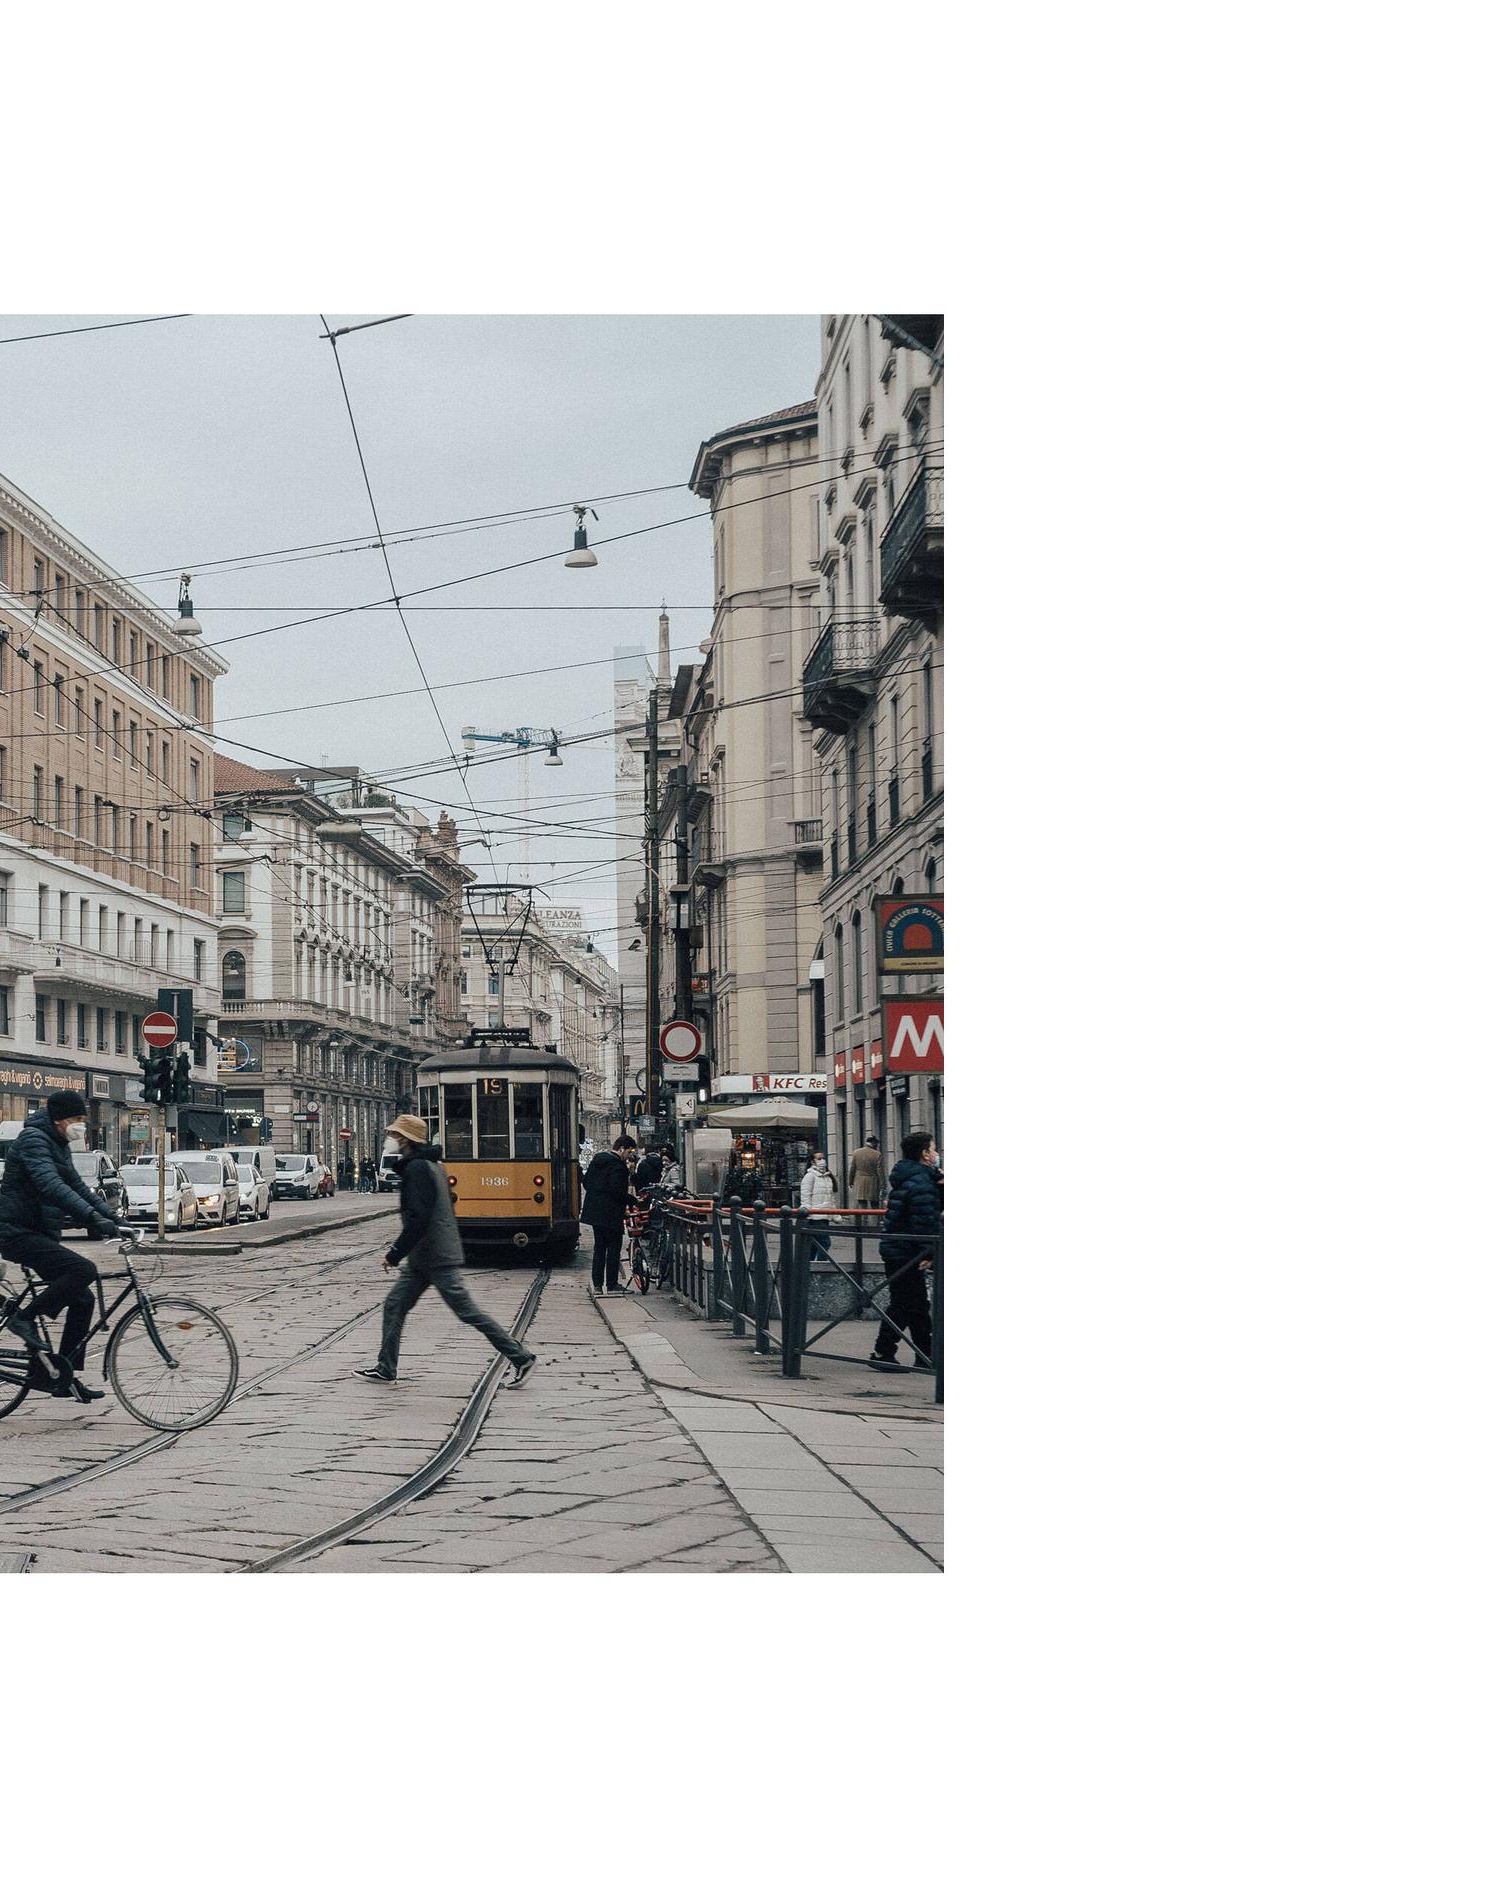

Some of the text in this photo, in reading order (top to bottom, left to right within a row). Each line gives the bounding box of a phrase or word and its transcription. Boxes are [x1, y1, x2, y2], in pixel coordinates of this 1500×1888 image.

[890, 1015, 944, 1057] M
[483, 1078, 502, 1095] 19
[773, 1078, 827, 1089] KFC Res
[481, 1176, 509, 1186] 1936
